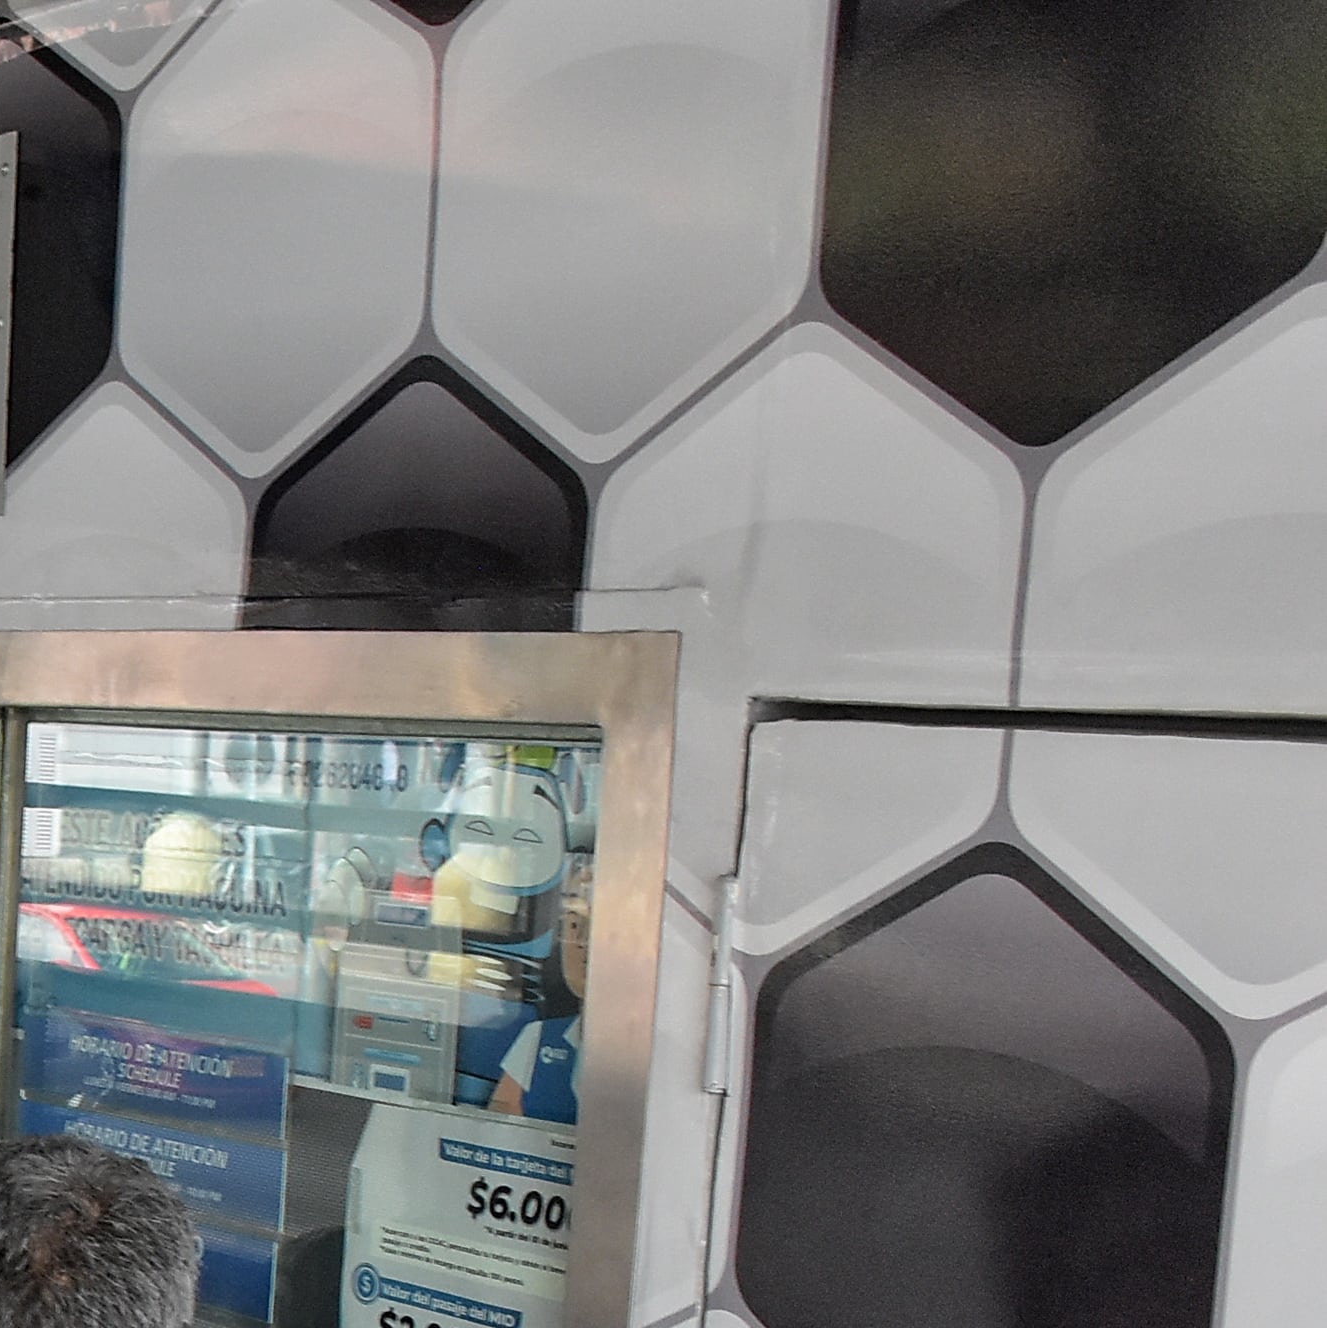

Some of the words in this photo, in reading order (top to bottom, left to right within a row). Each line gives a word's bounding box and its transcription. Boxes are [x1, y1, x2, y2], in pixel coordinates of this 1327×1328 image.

[68, 1034, 134, 1060] HORARIO
[136, 1043, 155, 1064] DE
[157, 1049, 234, 1079] ATENCIÓN
[117, 1063, 183, 1088] SCHEDULE
[64, 1120, 128, 1148] HORARIO
[129, 1132, 151, 1152] DE
[153, 1138, 229, 1169] ATENCIÓN
[466, 1176, 572, 1231] $6.00
